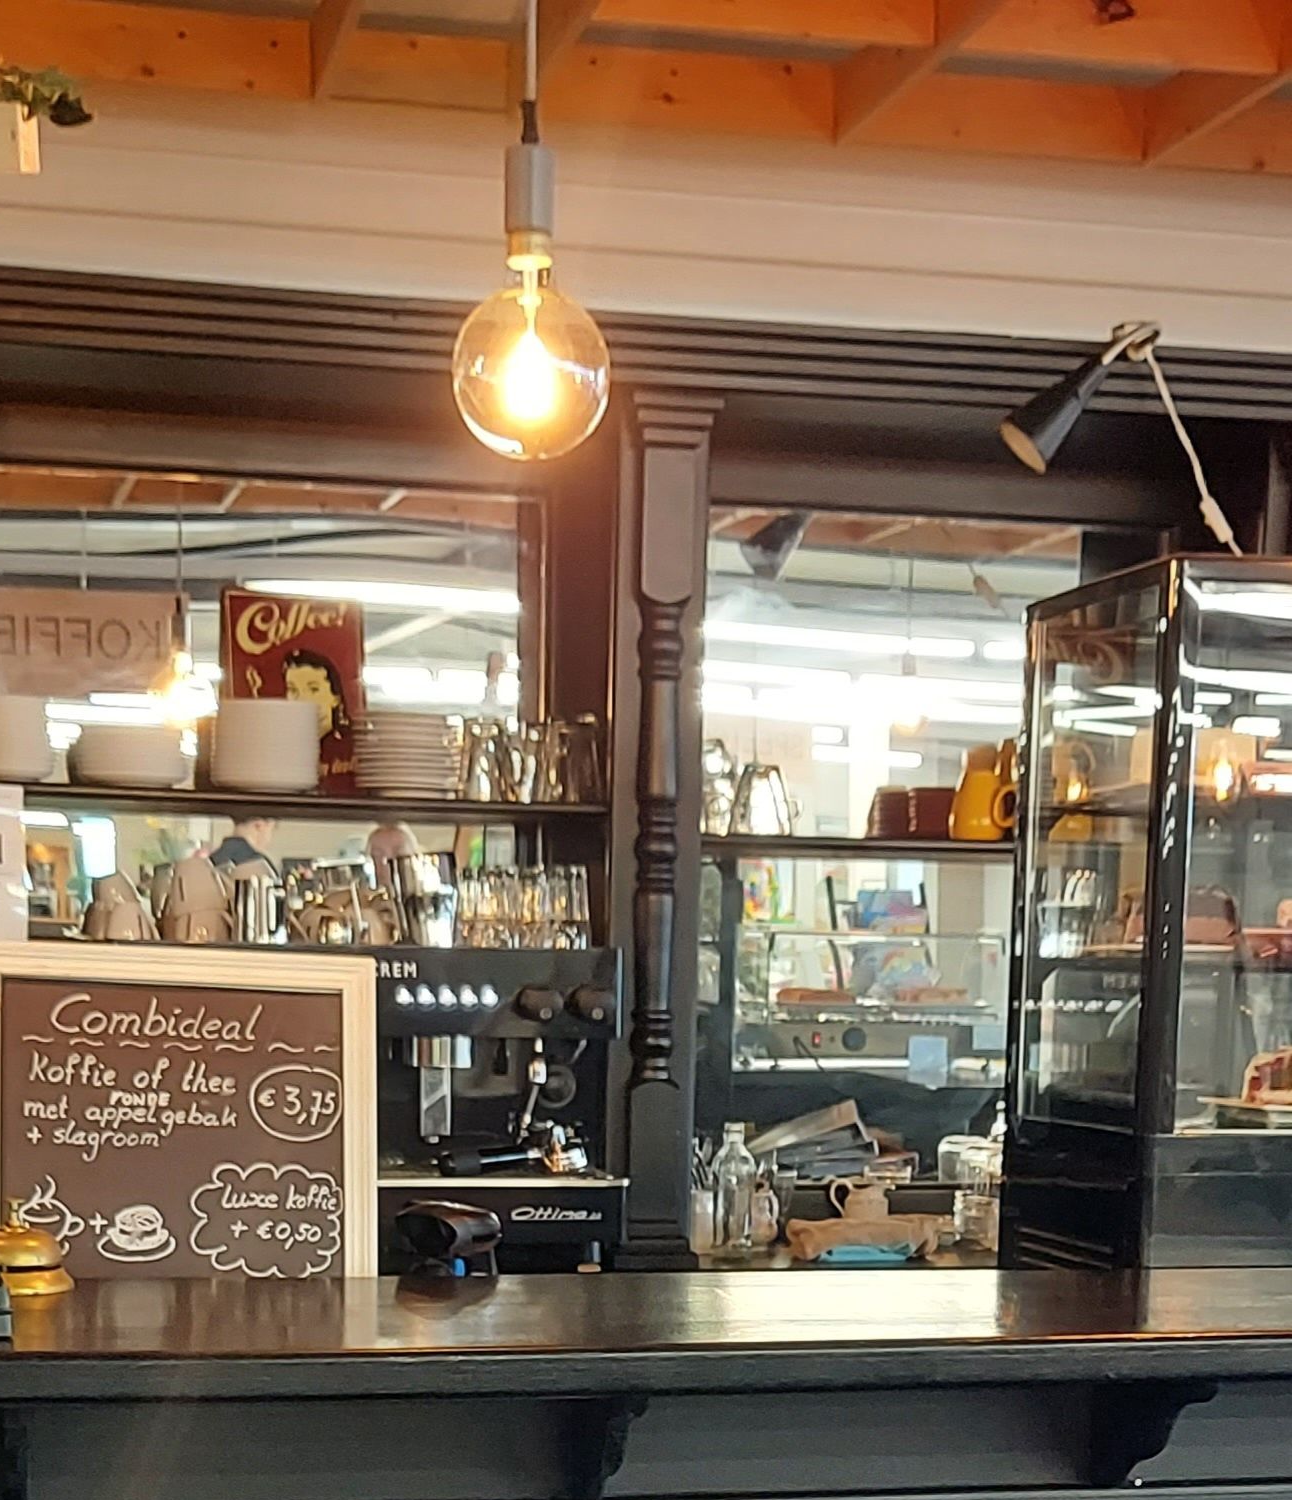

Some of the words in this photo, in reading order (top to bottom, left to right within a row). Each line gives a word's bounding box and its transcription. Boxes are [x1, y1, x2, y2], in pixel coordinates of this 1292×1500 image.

[375, 960, 418, 979] REM
[50, 993, 262, 1042] Combideal
[132, 1057, 170, 1090] of
[181, 1059, 237, 1095] thee
[23, 1095, 68, 1120] met
[53, 1120, 160, 1162] slagroom
